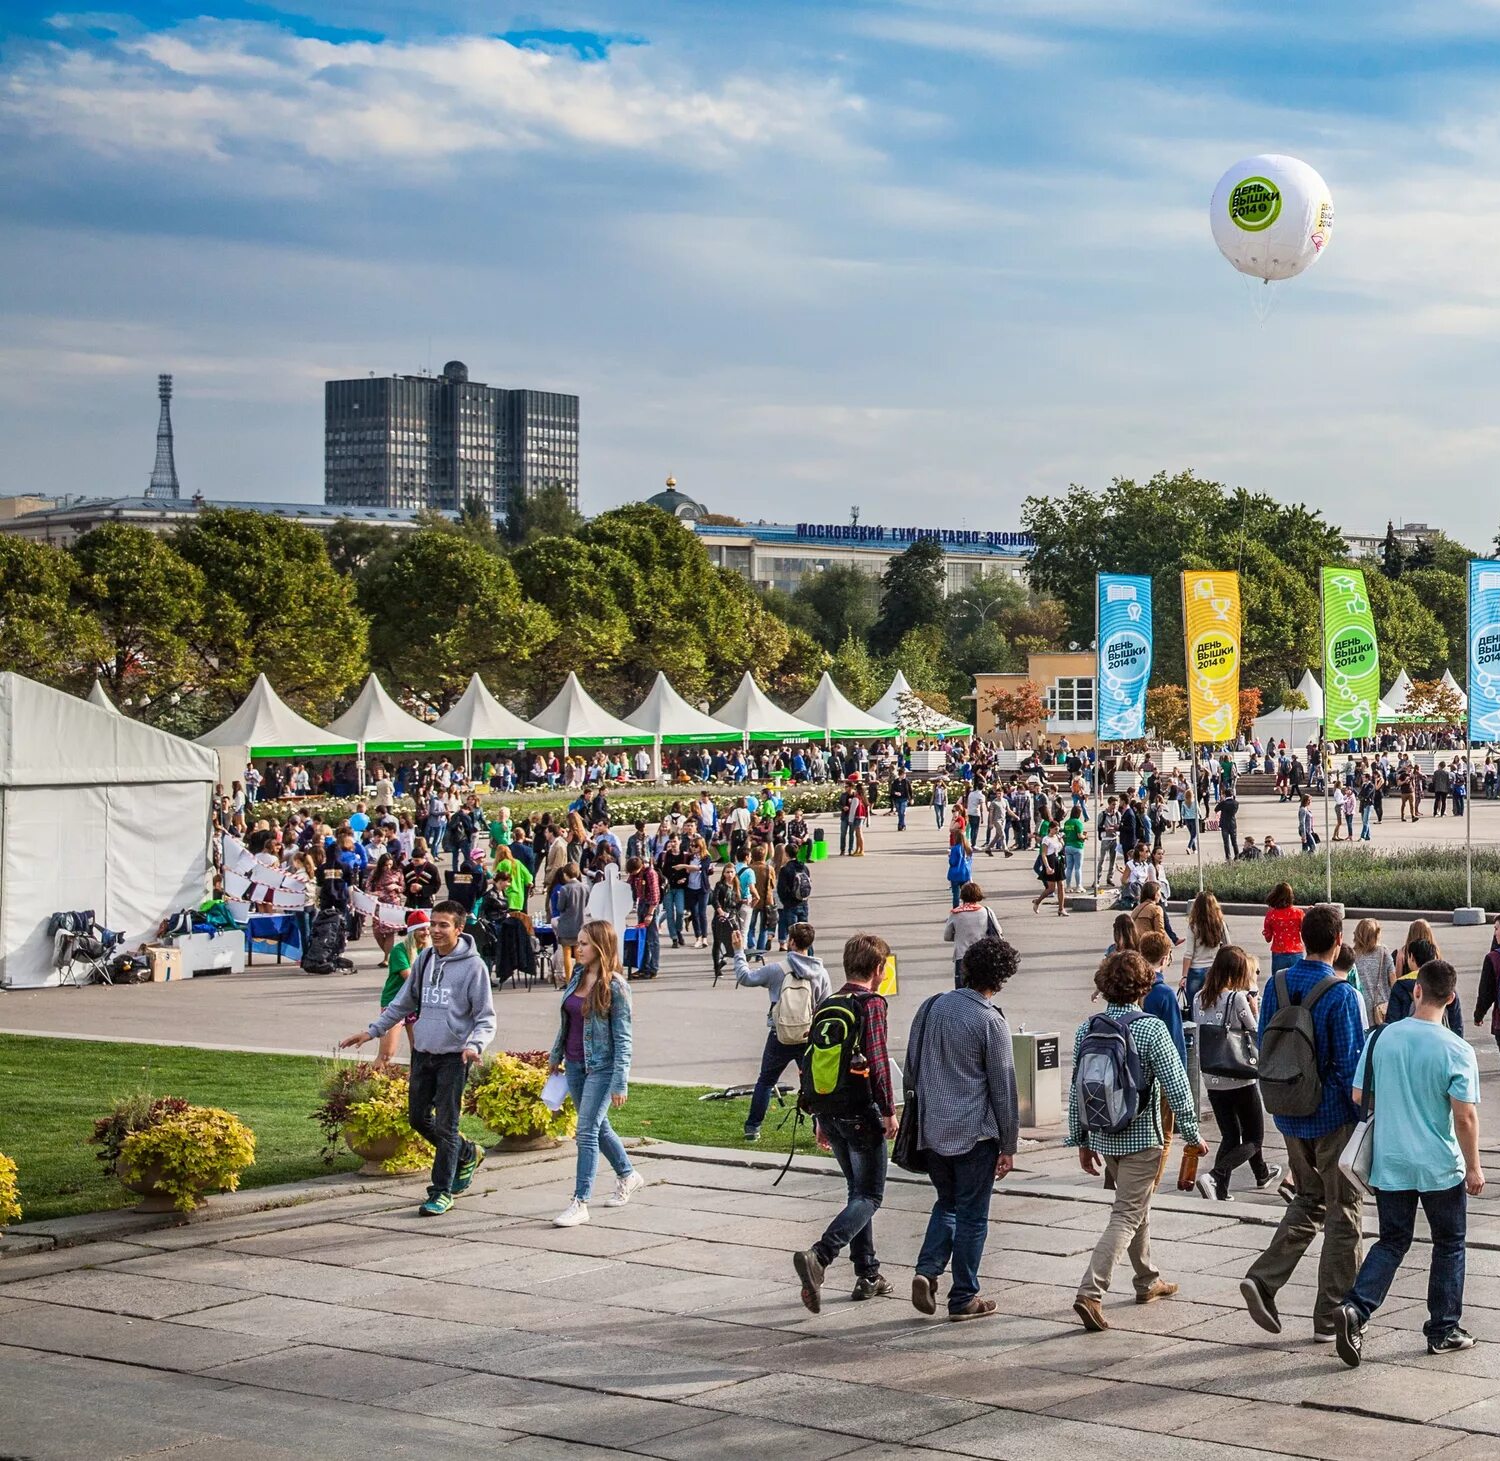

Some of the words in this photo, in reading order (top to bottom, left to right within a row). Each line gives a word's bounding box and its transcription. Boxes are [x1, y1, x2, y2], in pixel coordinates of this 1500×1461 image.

[1233, 184, 1265, 200] ДЕНЬ
[1232, 191, 1280, 208] ВЫШКИ
[1232, 204, 1257, 218] 2014
[797, 522, 884, 541] МОСКОВСКИЙ
[1108, 641, 1133, 654] ДЕНЬ
[1197, 641, 1222, 653] ДЕНЬ
[1334, 637, 1361, 651] ДЕНЬ
[1335, 643, 1374, 659] ВЫШКИ
[1108, 647, 1146, 661] ВЫШКИ
[1197, 646, 1234, 661] ВЫШКИ
[1478, 653, 1500, 664] 2014
[1108, 658, 1129, 670] 2014
[1197, 658, 1218, 670] 2014
[1335, 656, 1357, 668] 2014
[422, 987, 451, 1005] HSE
